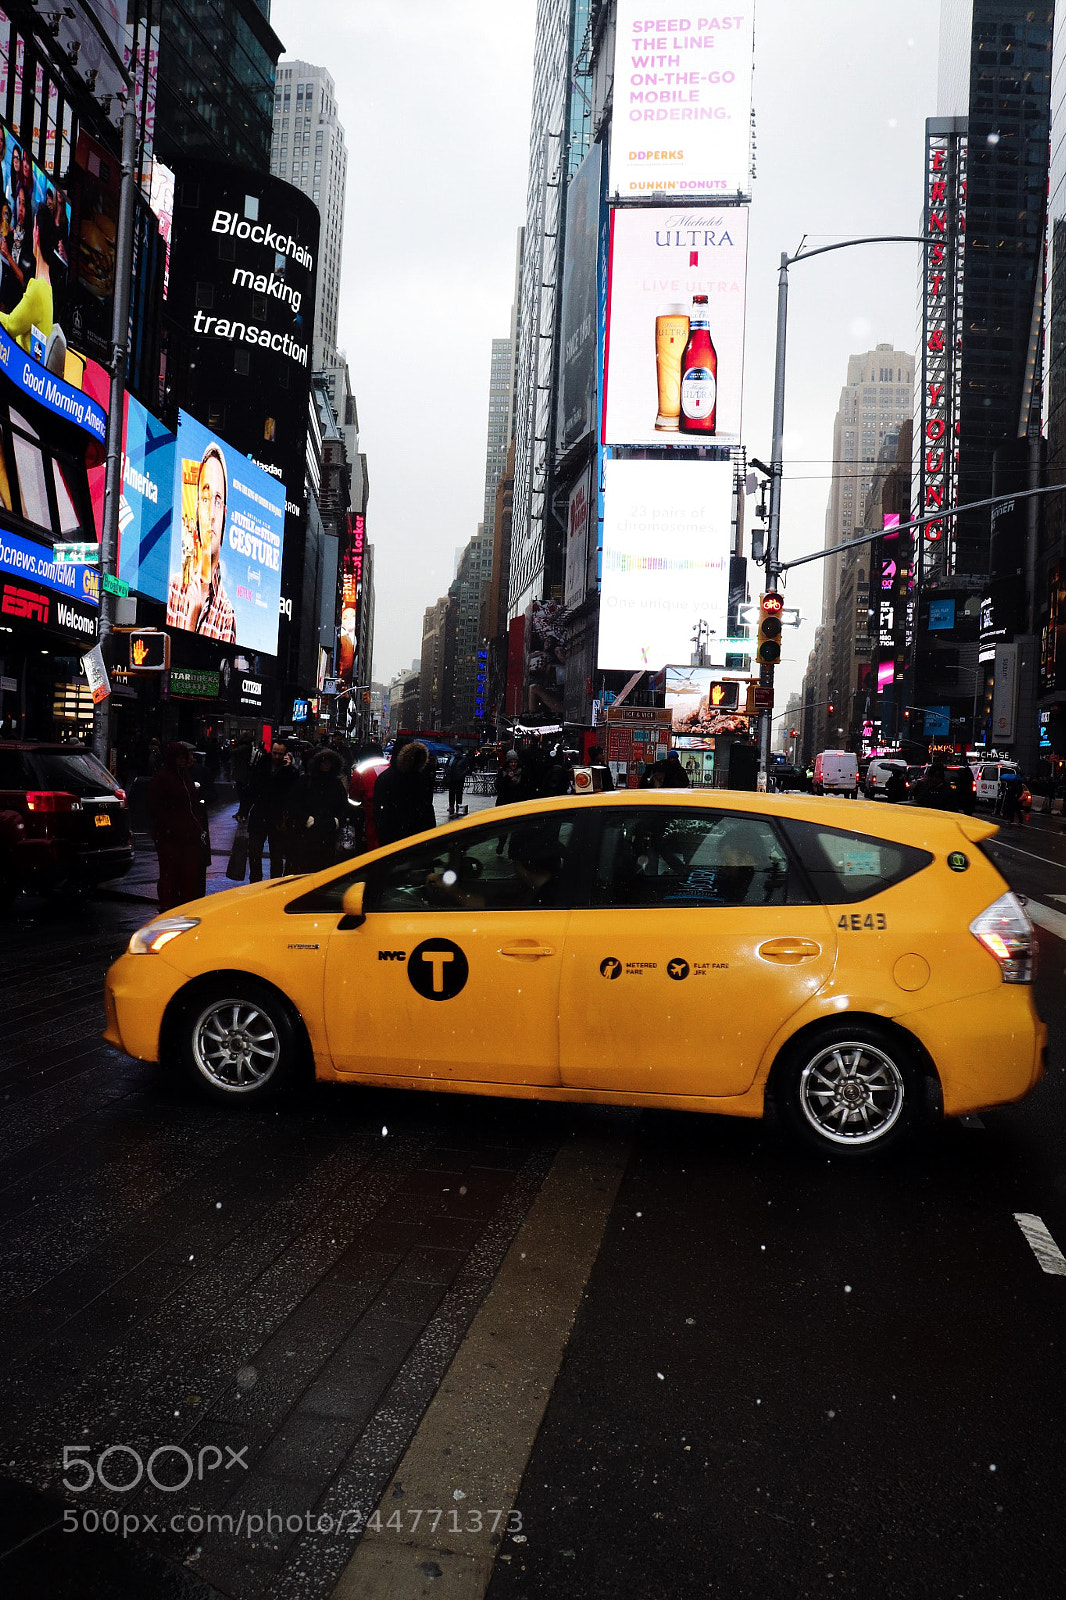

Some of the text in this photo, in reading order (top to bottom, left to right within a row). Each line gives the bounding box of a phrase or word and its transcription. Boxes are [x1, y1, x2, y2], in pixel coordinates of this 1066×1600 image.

[632, 16, 744, 33] SPEED PAST
[632, 35, 715, 51] THE LINE
[631, 54, 680, 68] WITH
[630, 70, 735, 86] ON-THE-GO
[630, 89, 700, 104] MOBILE
[628, 105, 732, 122] ORDERING.
[665, 215, 724, 229] Michelob
[928, 150, 947, 296] ERNST
[211, 209, 313, 272] Blockchain
[655, 230, 735, 246] ULTRA
[232, 268, 302, 313] making
[642, 279, 741, 294] LIVE ULTRA
[22, 363, 45, 396] Good
[45, 380, 85, 423] Morning
[924, 385, 946, 541] YOUNG
[123, 456, 158, 504] America
[631, 505, 706, 521] 23 pairs of
[352, 515, 365, 553] Locker
[616, 519, 718, 534] chromosomes.
[261, 526, 281, 547] STUPID
[229, 524, 280, 572] GESTURE
[2, 584, 50, 624] ESPN
[606, 596, 722, 612] One unique you.
[57, 602, 94, 635] Welcome
[980, 750, 1010, 759] CHASE
[837, 912, 887, 931] 4E43
[378, 950, 455, 993] NYC T
